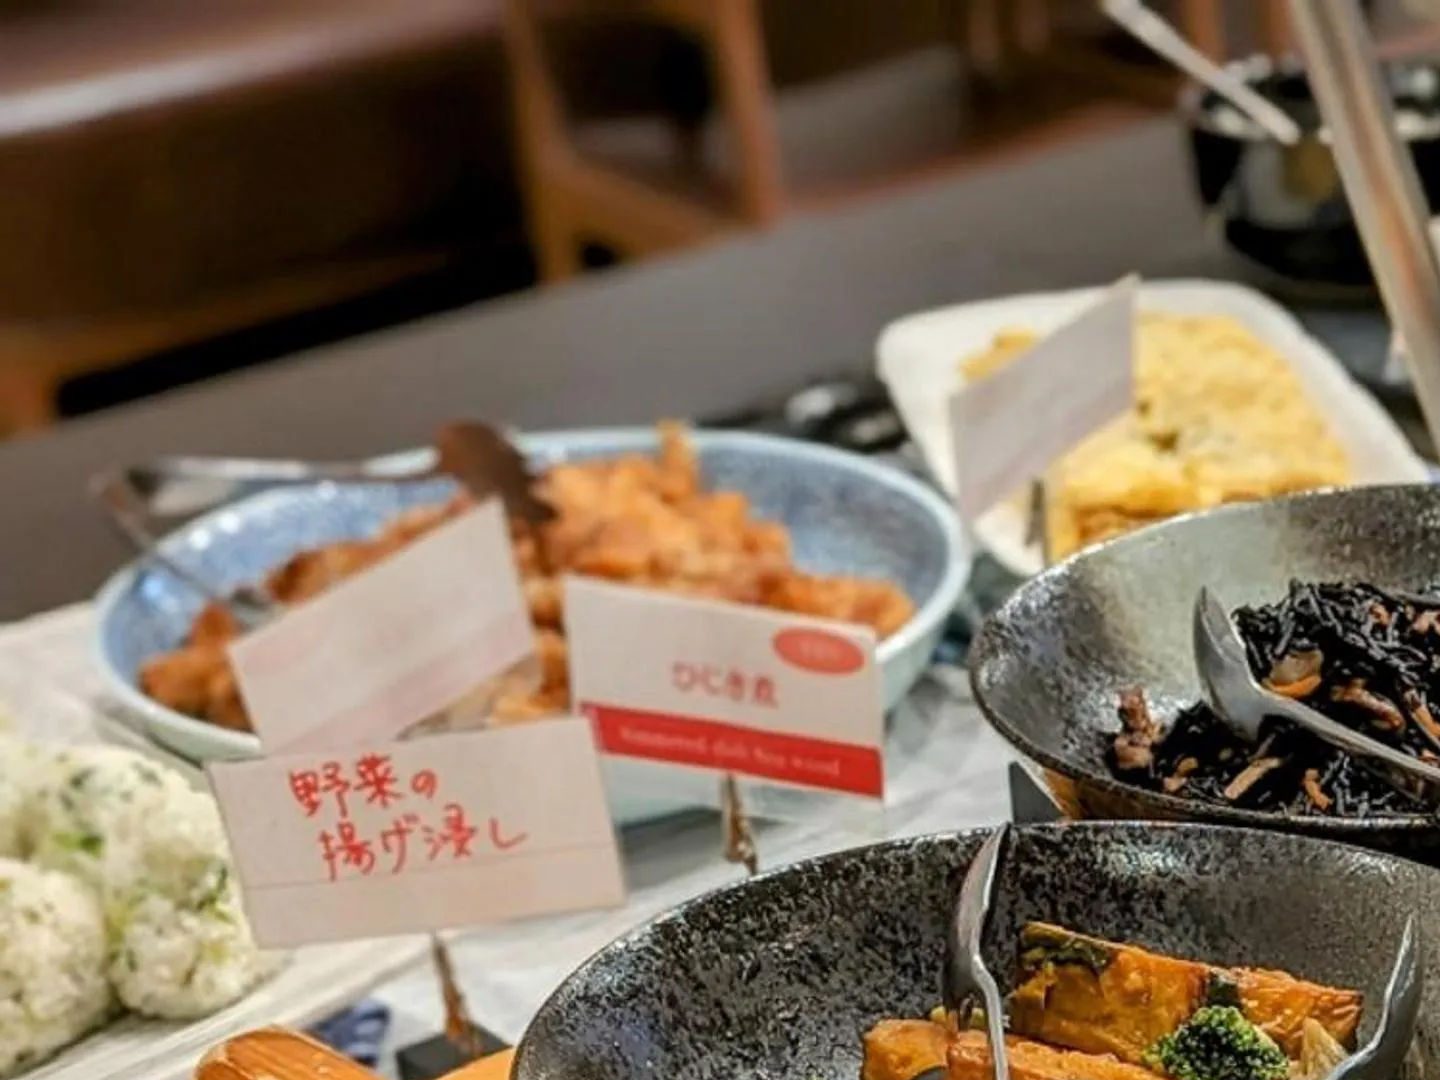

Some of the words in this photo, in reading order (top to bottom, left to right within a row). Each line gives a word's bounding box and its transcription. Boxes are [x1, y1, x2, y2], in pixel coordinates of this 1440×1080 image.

[289, 754, 438, 818] 野菜の
[318, 803, 528, 882] 揚げ浸し
